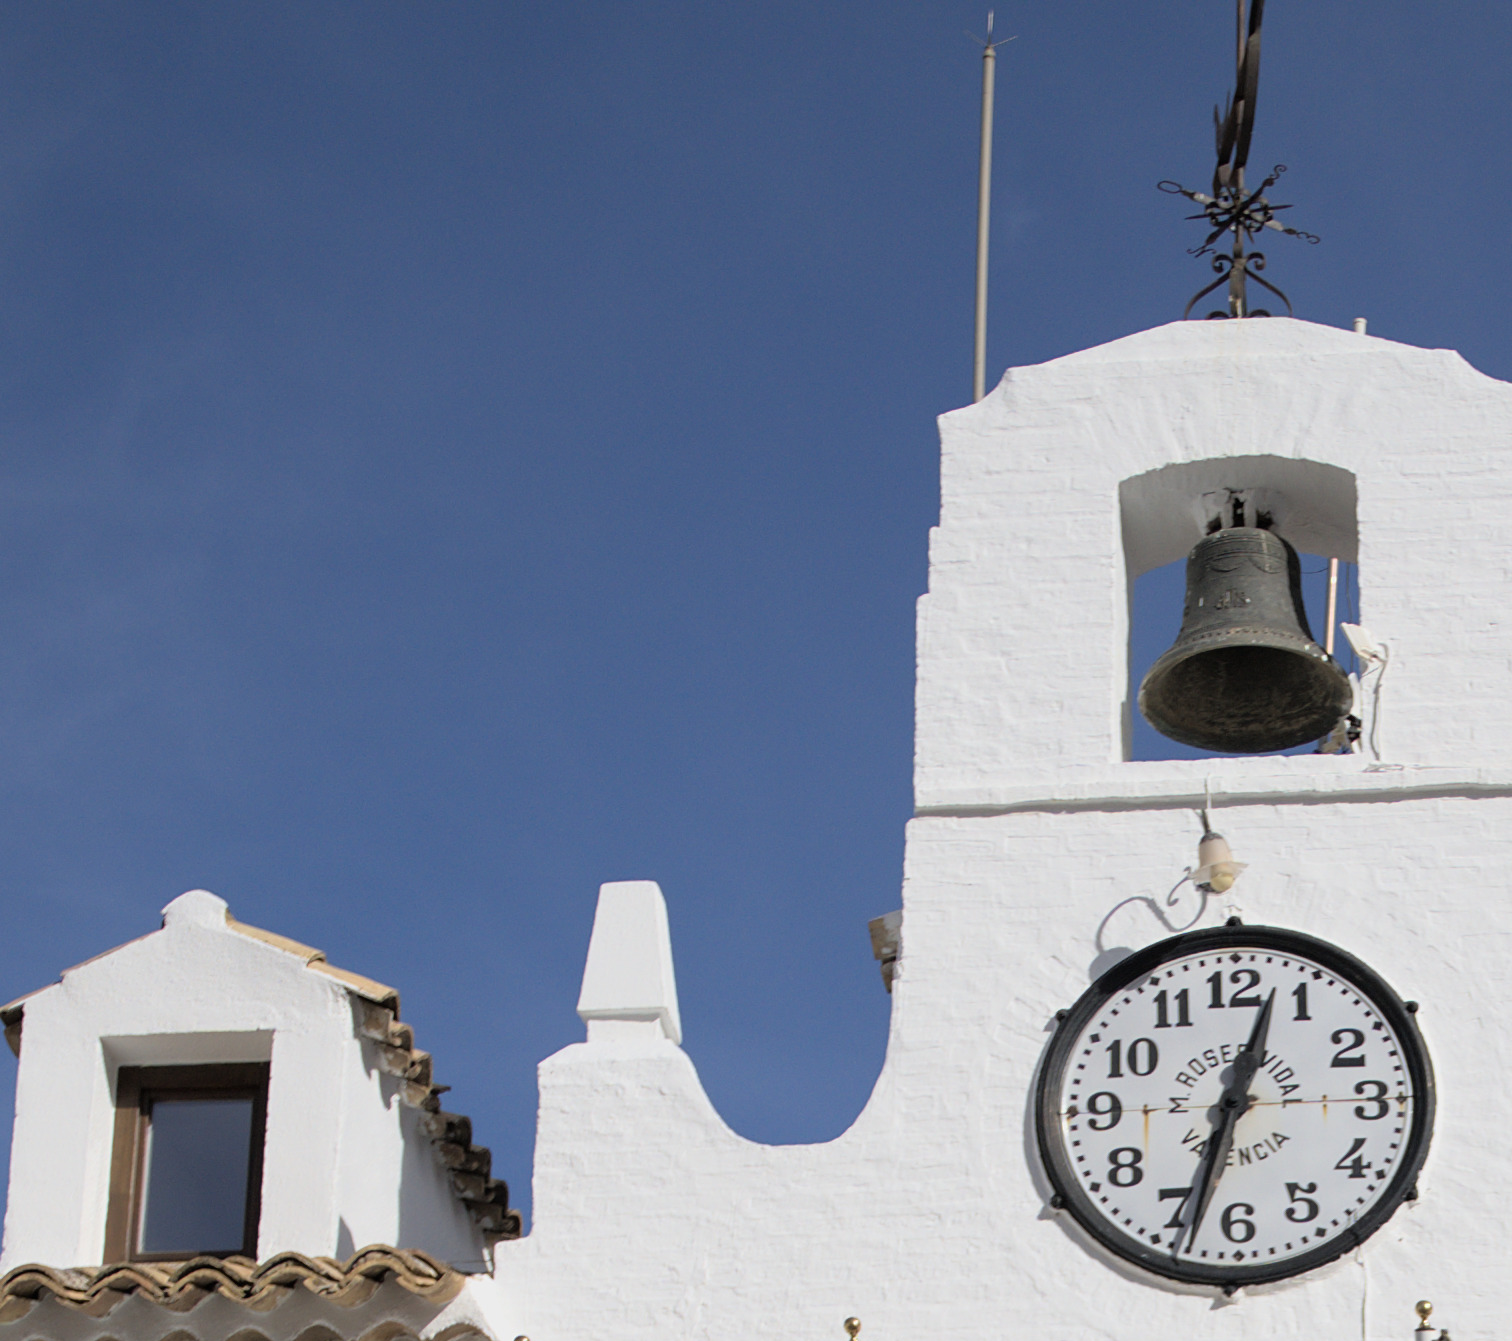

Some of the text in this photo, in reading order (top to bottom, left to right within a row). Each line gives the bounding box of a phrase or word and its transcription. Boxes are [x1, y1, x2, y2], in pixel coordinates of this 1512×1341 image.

[1153, 988, 1193, 1029] 11
[1206, 969, 1262, 1009] 12
[1291, 982, 1312, 1021] 1
[1105, 1037, 1159, 1079] 10
[1330, 1028, 1366, 1068] 2
[1259, 1050, 1303, 1108] VIDAL
[1087, 1091, 1122, 1131] 9
[1354, 1080, 1389, 1121] 3
[1107, 1147, 1144, 1188] 8
[1181, 1128, 1290, 1167] VAENCIA
[1334, 1138, 1372, 1179] 4
[1158, 1187, 1194, 1229] 7
[1285, 1182, 1320, 1223] 5
[1221, 1203, 1256, 1244] 6
